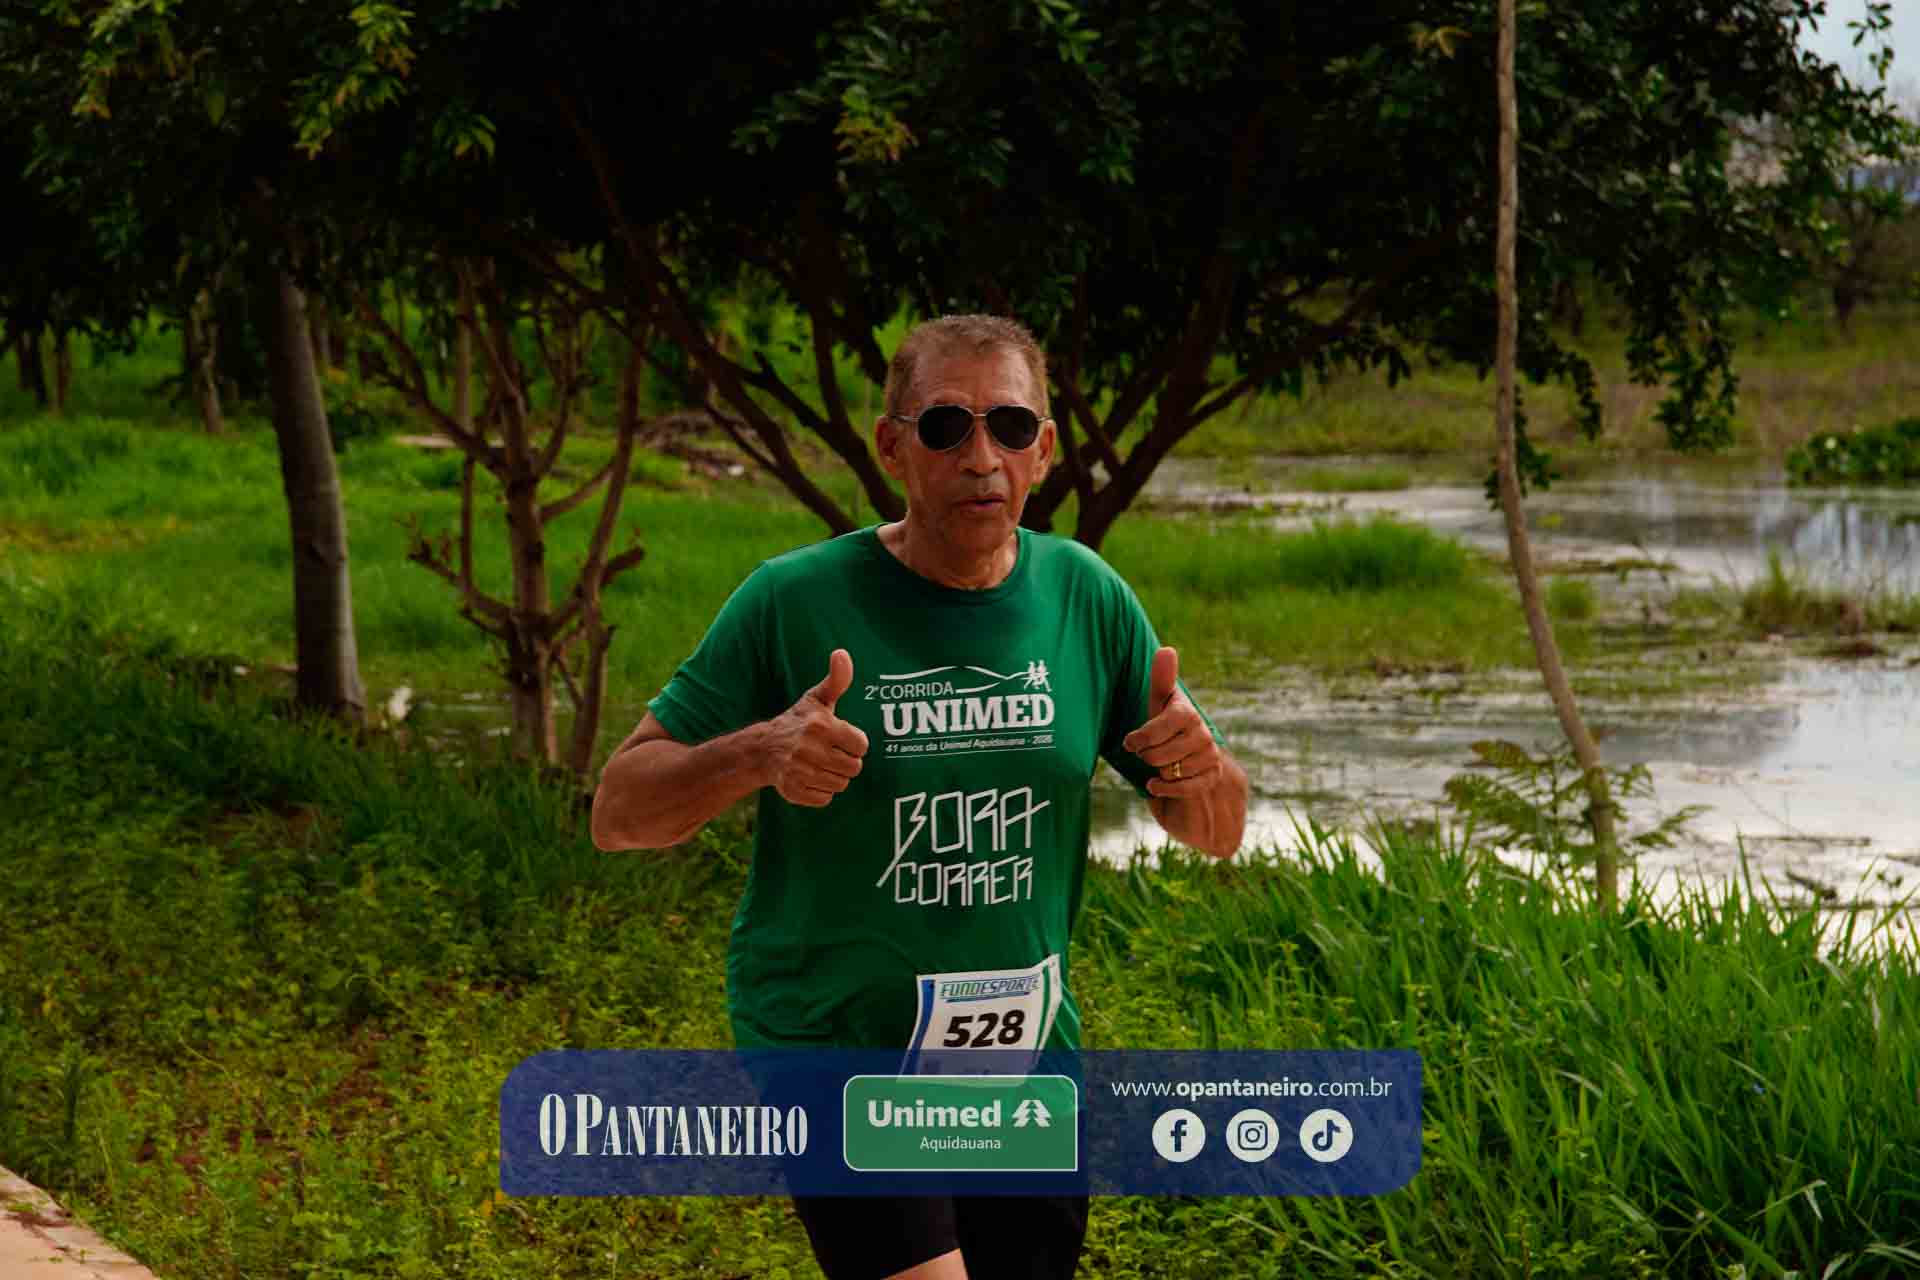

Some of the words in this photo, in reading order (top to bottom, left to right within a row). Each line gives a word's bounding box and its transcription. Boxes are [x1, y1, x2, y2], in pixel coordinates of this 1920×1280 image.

[881, 694, 1054, 736] UNIMED
[885, 744, 898, 753] 41
[877, 786, 1050, 886] BORA
[895, 855, 1033, 906] CORRER
[943, 1009, 1025, 1048] 528
